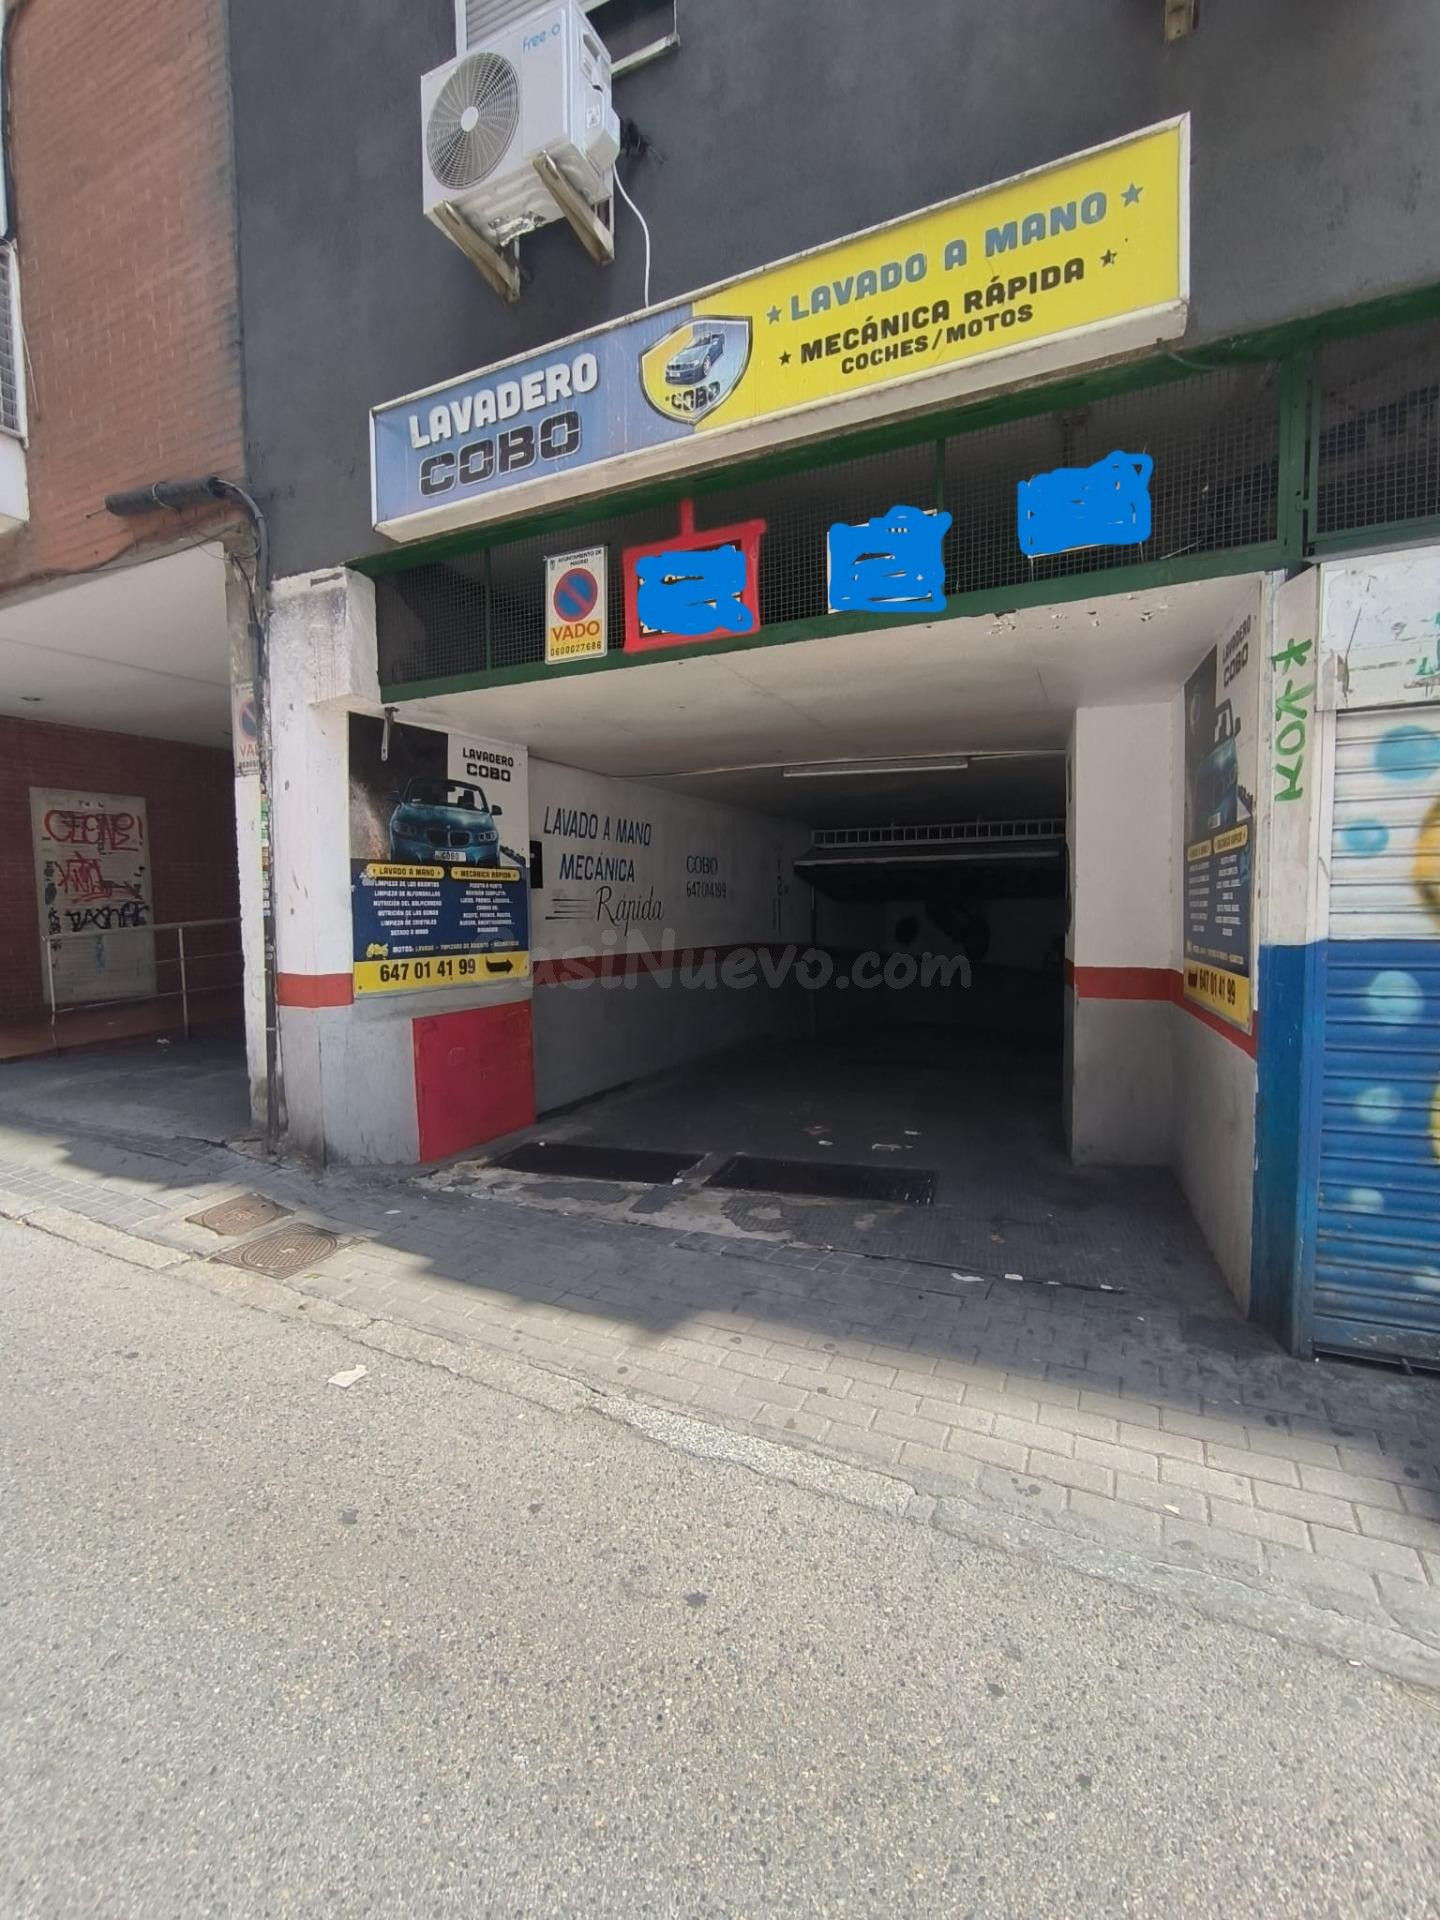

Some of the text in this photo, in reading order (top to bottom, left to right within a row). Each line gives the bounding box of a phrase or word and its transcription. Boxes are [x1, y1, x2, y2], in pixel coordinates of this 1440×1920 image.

[790, 191, 1108, 321] LAVADO A MANO
[800, 257, 1085, 364] MECÁNICA RÁPIDA
[841, 303, 1034, 375] COCHES/MOTOS
[409, 352, 599, 449] LAVADERO
[671, 381, 721, 411] COBO
[419, 410, 583, 497] COBO
[552, 620, 601, 641] VADO
[1223, 641, 1248, 688] COBO
[462, 746, 515, 768] LAVADERO
[466, 762, 511, 782] COBO
[543, 806, 652, 846] LAVADO A MANO
[559, 851, 635, 882] MECÁNICA
[686, 855, 718, 875] COBO
[595, 886, 665, 936] Rápida
[380, 958, 476, 982] 647 01 41 99
